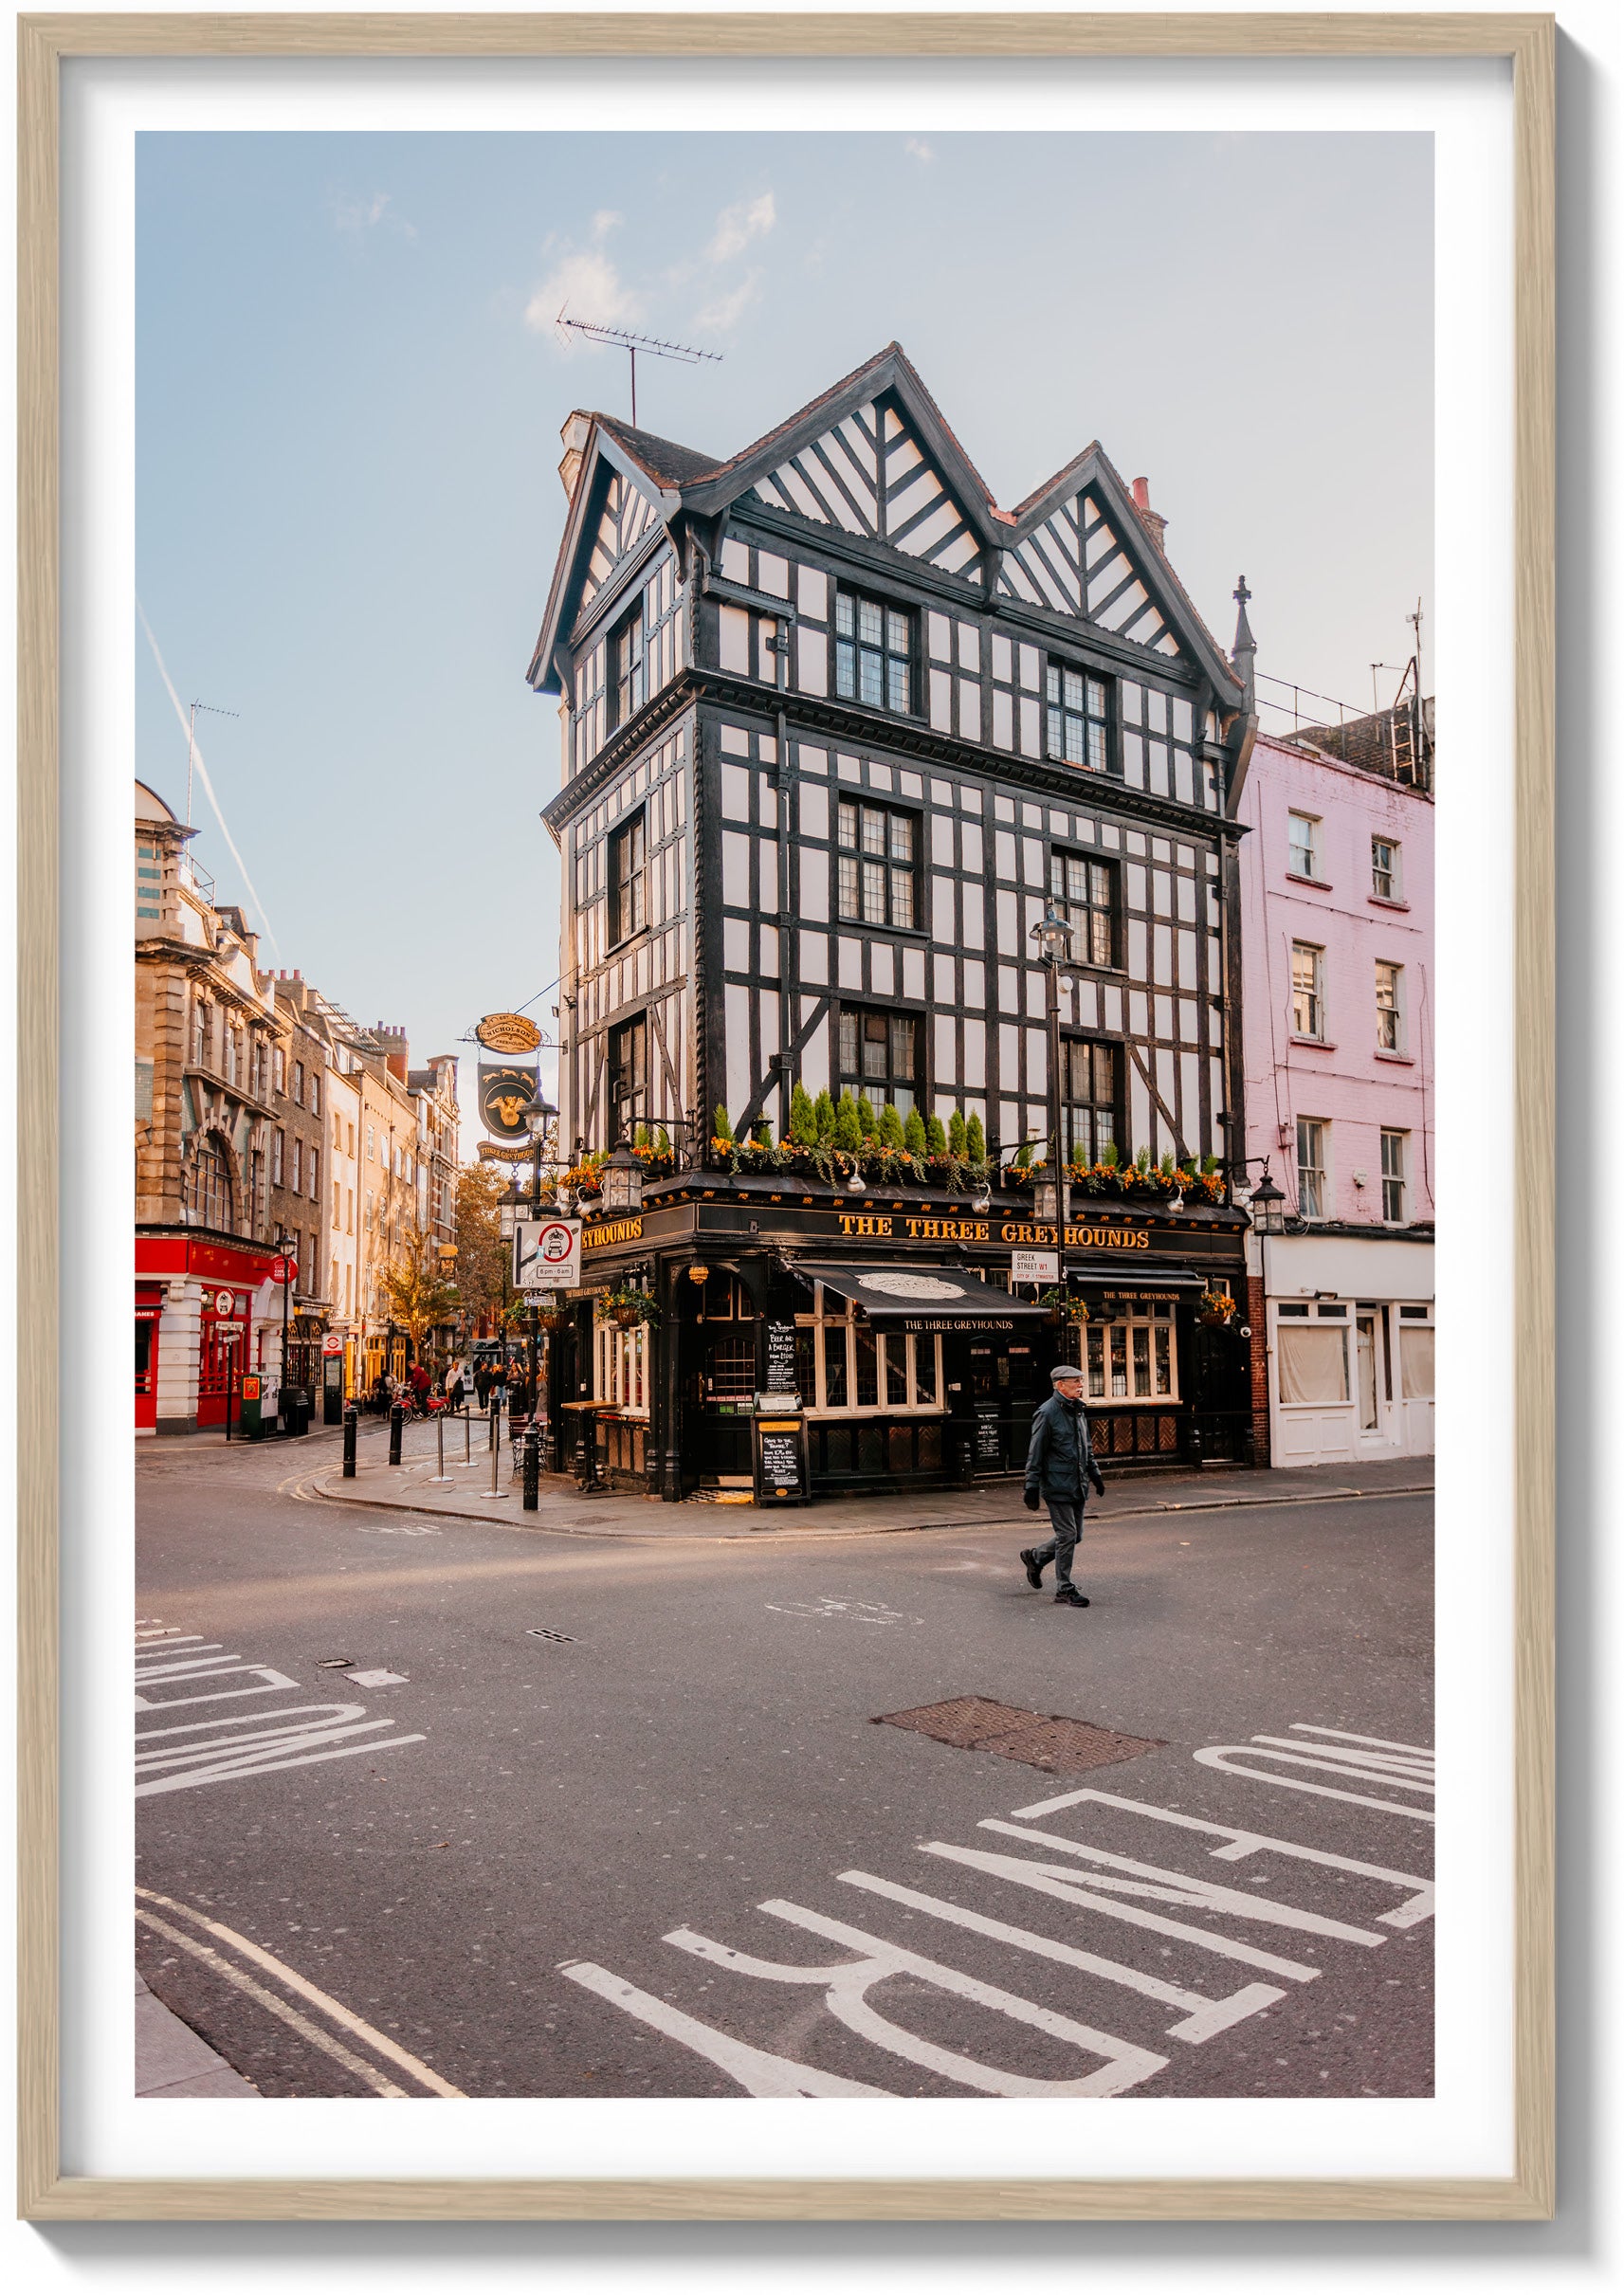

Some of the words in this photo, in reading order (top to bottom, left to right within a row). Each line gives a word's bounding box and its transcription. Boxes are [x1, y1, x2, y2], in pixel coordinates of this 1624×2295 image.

[486, 1026, 536, 1042] NICHOLSON'S
[481, 1146, 502, 1157] THREE
[838, 1214, 892, 1236] THE
[905, 1218, 990, 1241] THREE
[1001, 1223, 1149, 1248] GREYHOUNDS
[1016, 1262, 1037, 1270] STREET
[1118, 1291, 1138, 1300] THREE
[1140, 1292, 1180, 1301] GREYHOUNDS
[904, 1320, 922, 1330] THE
[923, 1320, 953, 1330] THREE
[954, 1320, 1013, 1330] GREYHOUNDS
